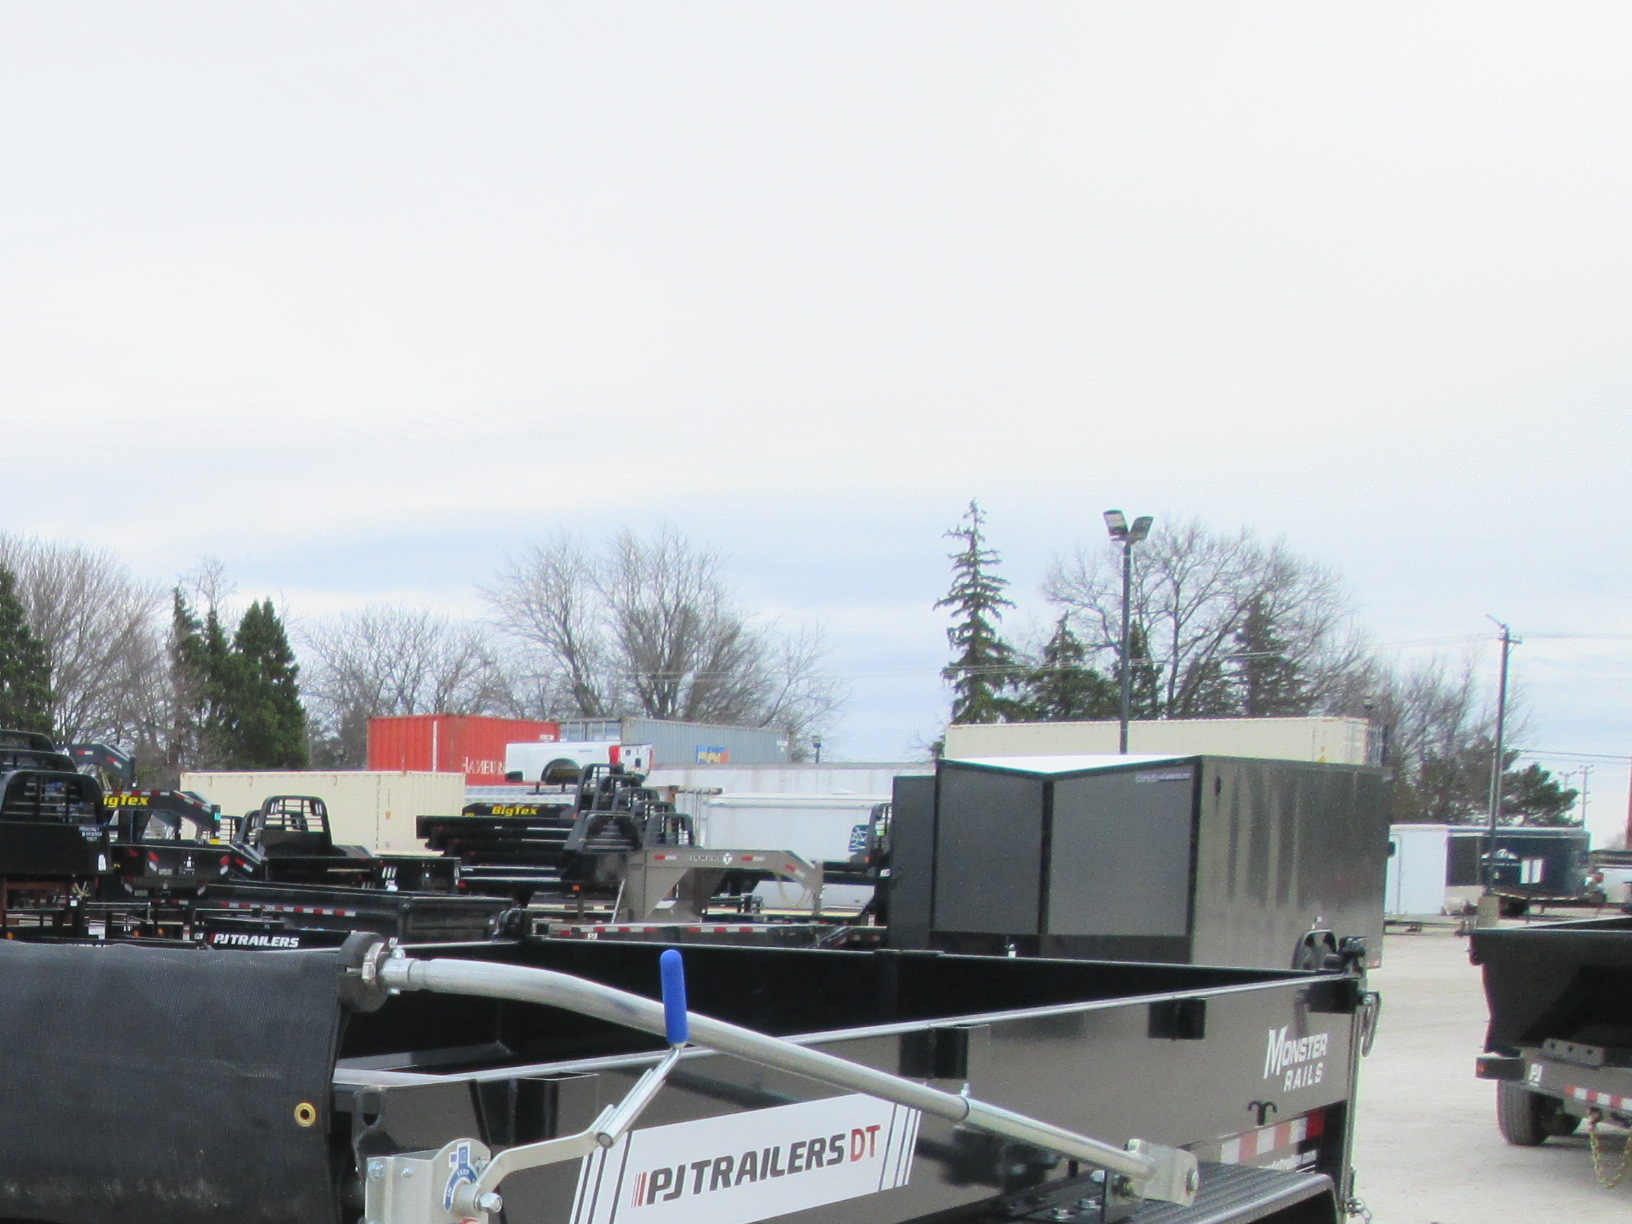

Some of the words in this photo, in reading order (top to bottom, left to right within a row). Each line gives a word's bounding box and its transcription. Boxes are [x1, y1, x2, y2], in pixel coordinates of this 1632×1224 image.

[103, 795, 150, 808] igTex
[491, 805, 538, 817] BigTex
[1283, 1062, 1324, 1092] RAILS
[849, 1124, 881, 1163] DT
